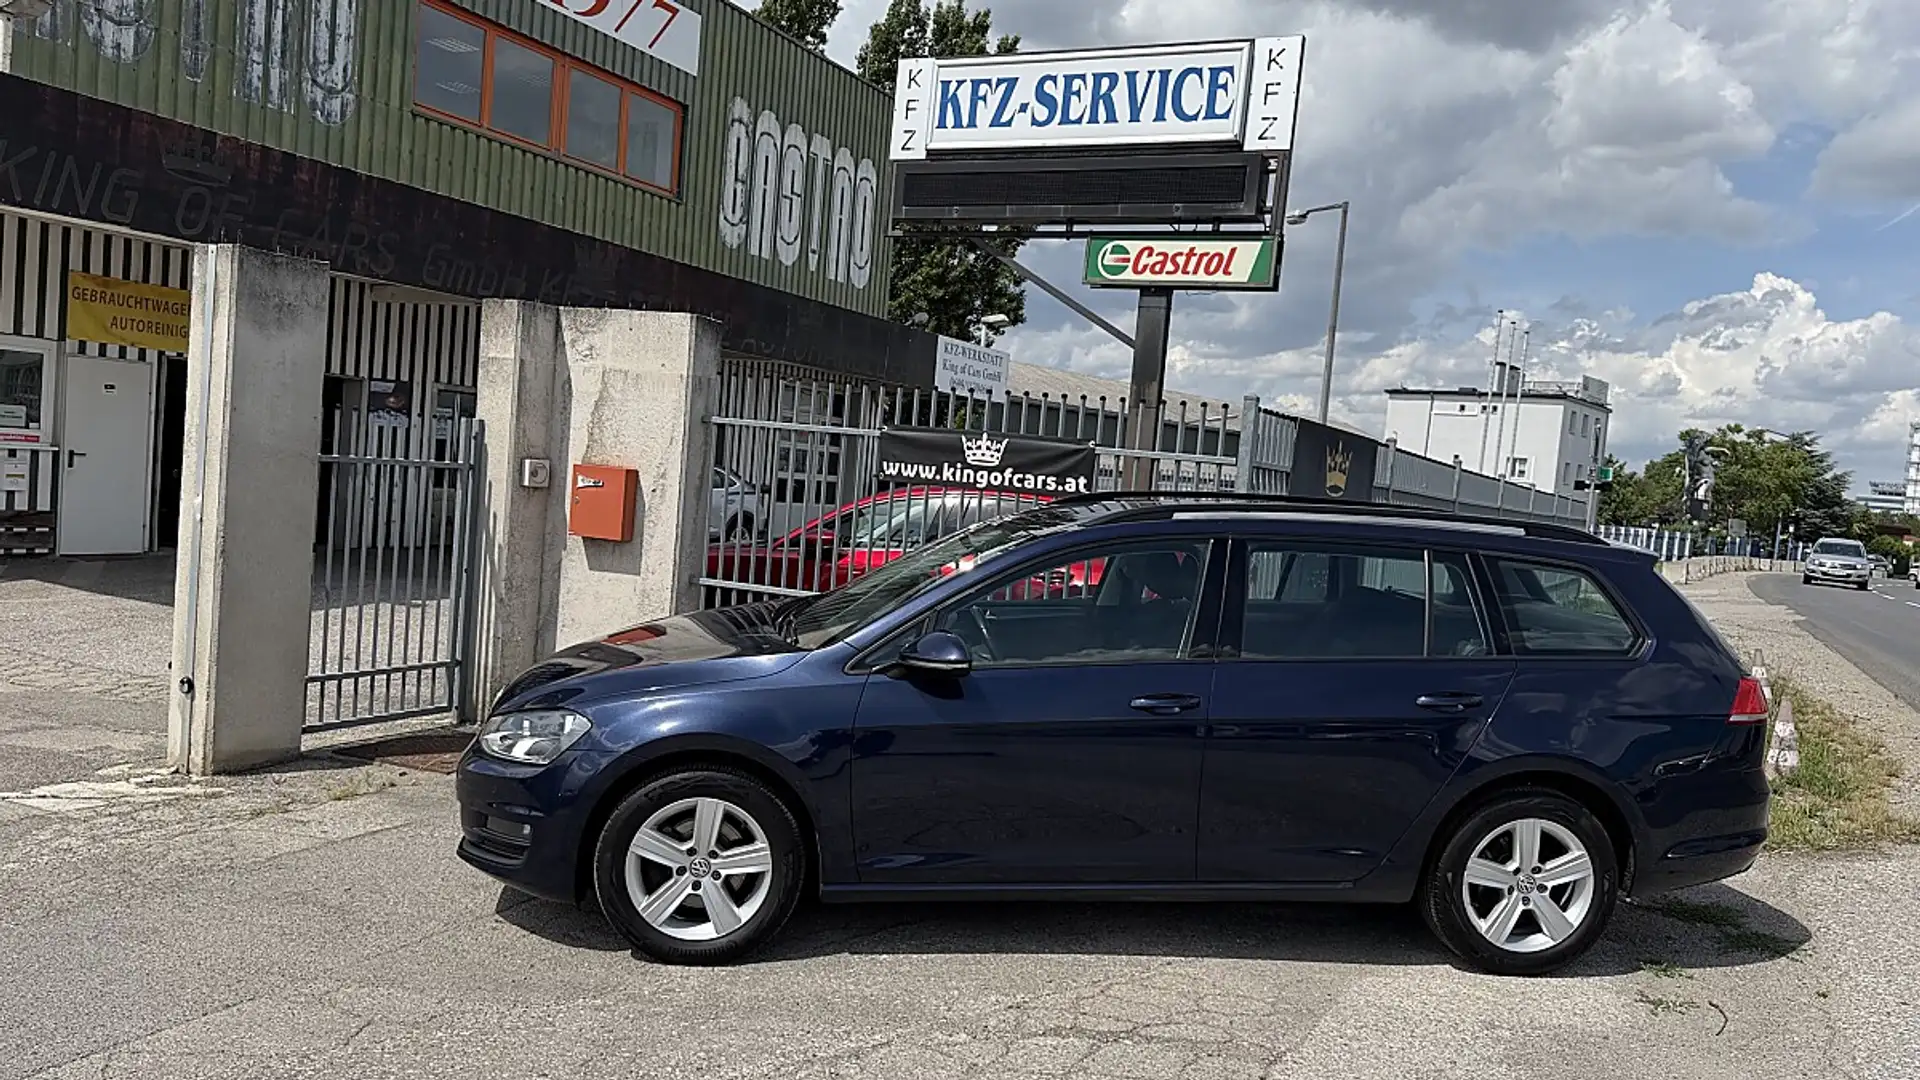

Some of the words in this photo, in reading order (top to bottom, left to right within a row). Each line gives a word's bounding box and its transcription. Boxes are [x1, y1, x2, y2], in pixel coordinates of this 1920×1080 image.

[901, 68, 923, 151] KFZ
[936, 64, 1235, 129] KFZ-SERVICE
[1257, 48, 1286, 141] KFZ
[0, 139, 138, 223] KING
[1131, 246, 1237, 277] Castrol
[110, 315, 189, 339] AUTOREINIG
[883, 461, 1088, 493] www.kingofcars.at
